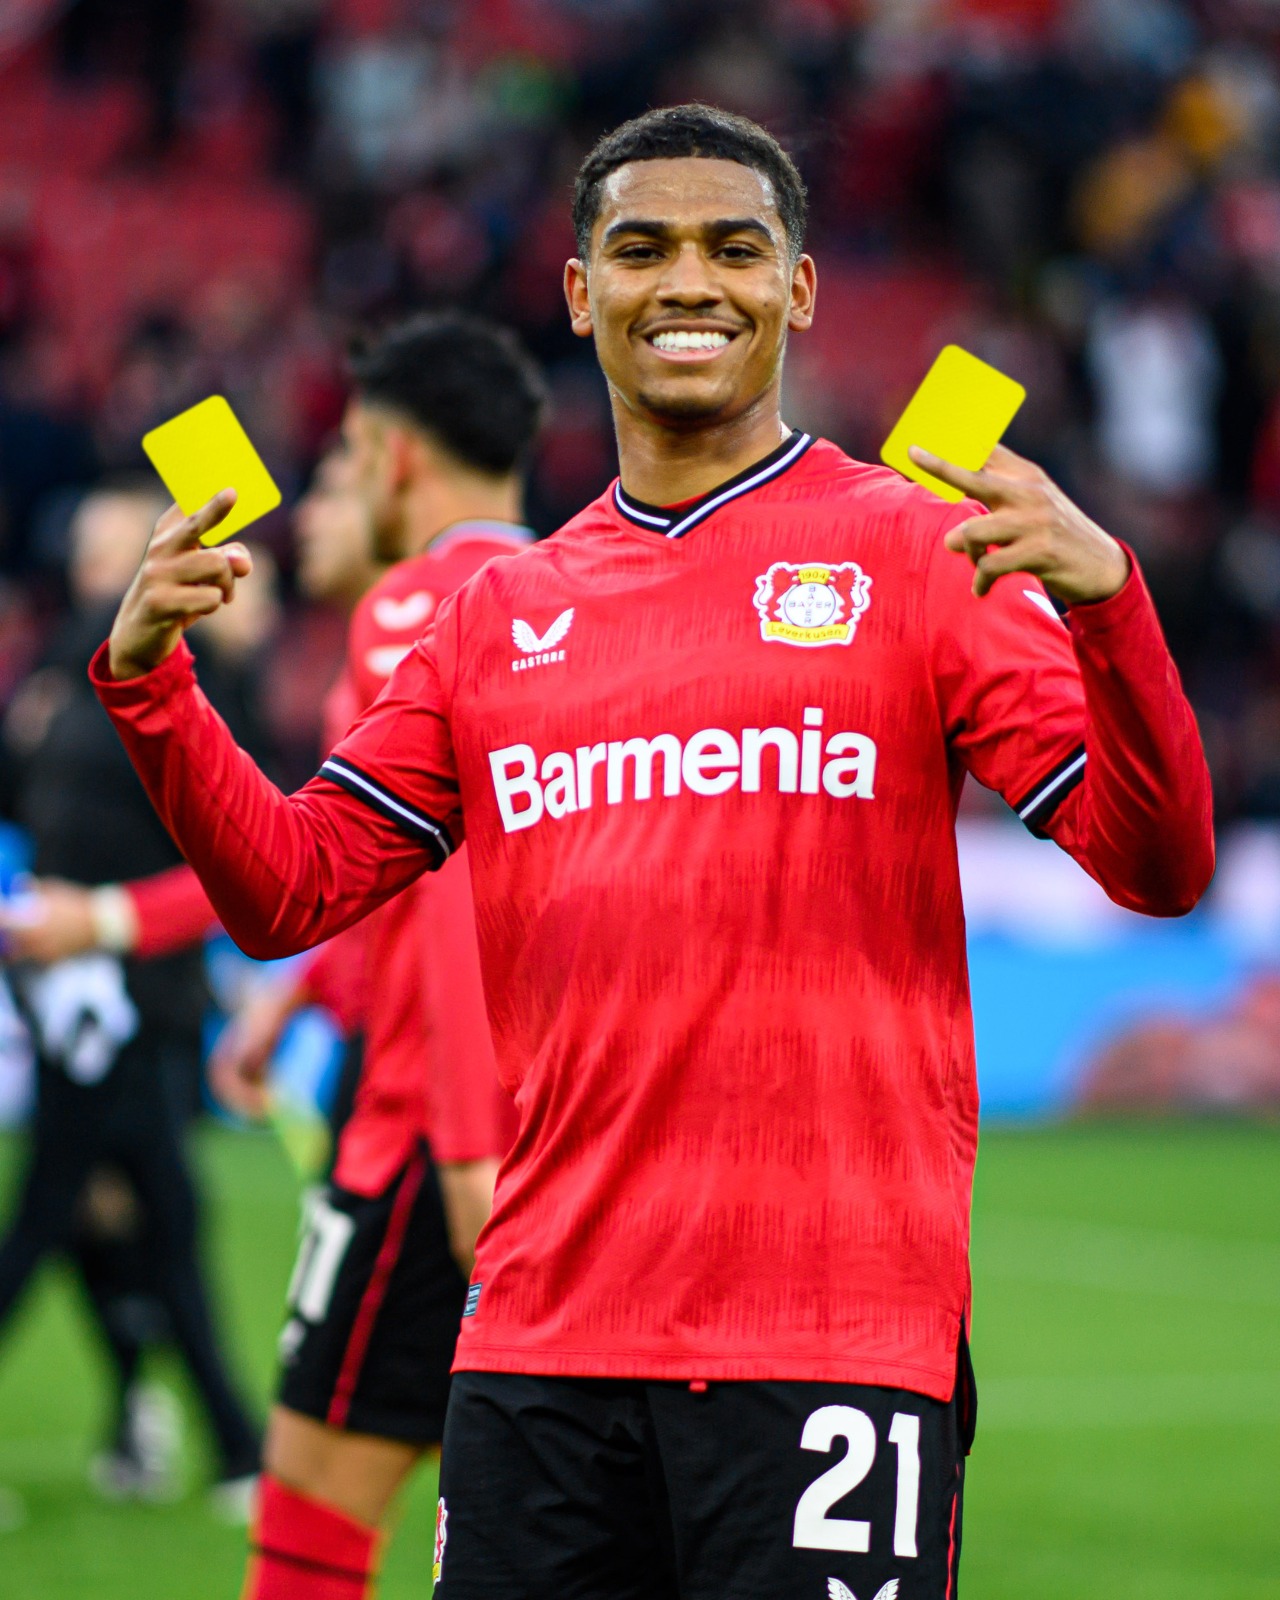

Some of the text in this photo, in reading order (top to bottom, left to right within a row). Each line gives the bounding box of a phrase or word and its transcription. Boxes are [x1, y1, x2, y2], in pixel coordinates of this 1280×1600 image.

[801, 571, 826, 580] 1904
[788, 601, 832, 609] BAYER
[770, 624, 842, 639] Leverkusen
[511, 649, 565, 671] CASTORE
[489, 706, 877, 833] Barmenia
[793, 1405, 920, 1558] 21
